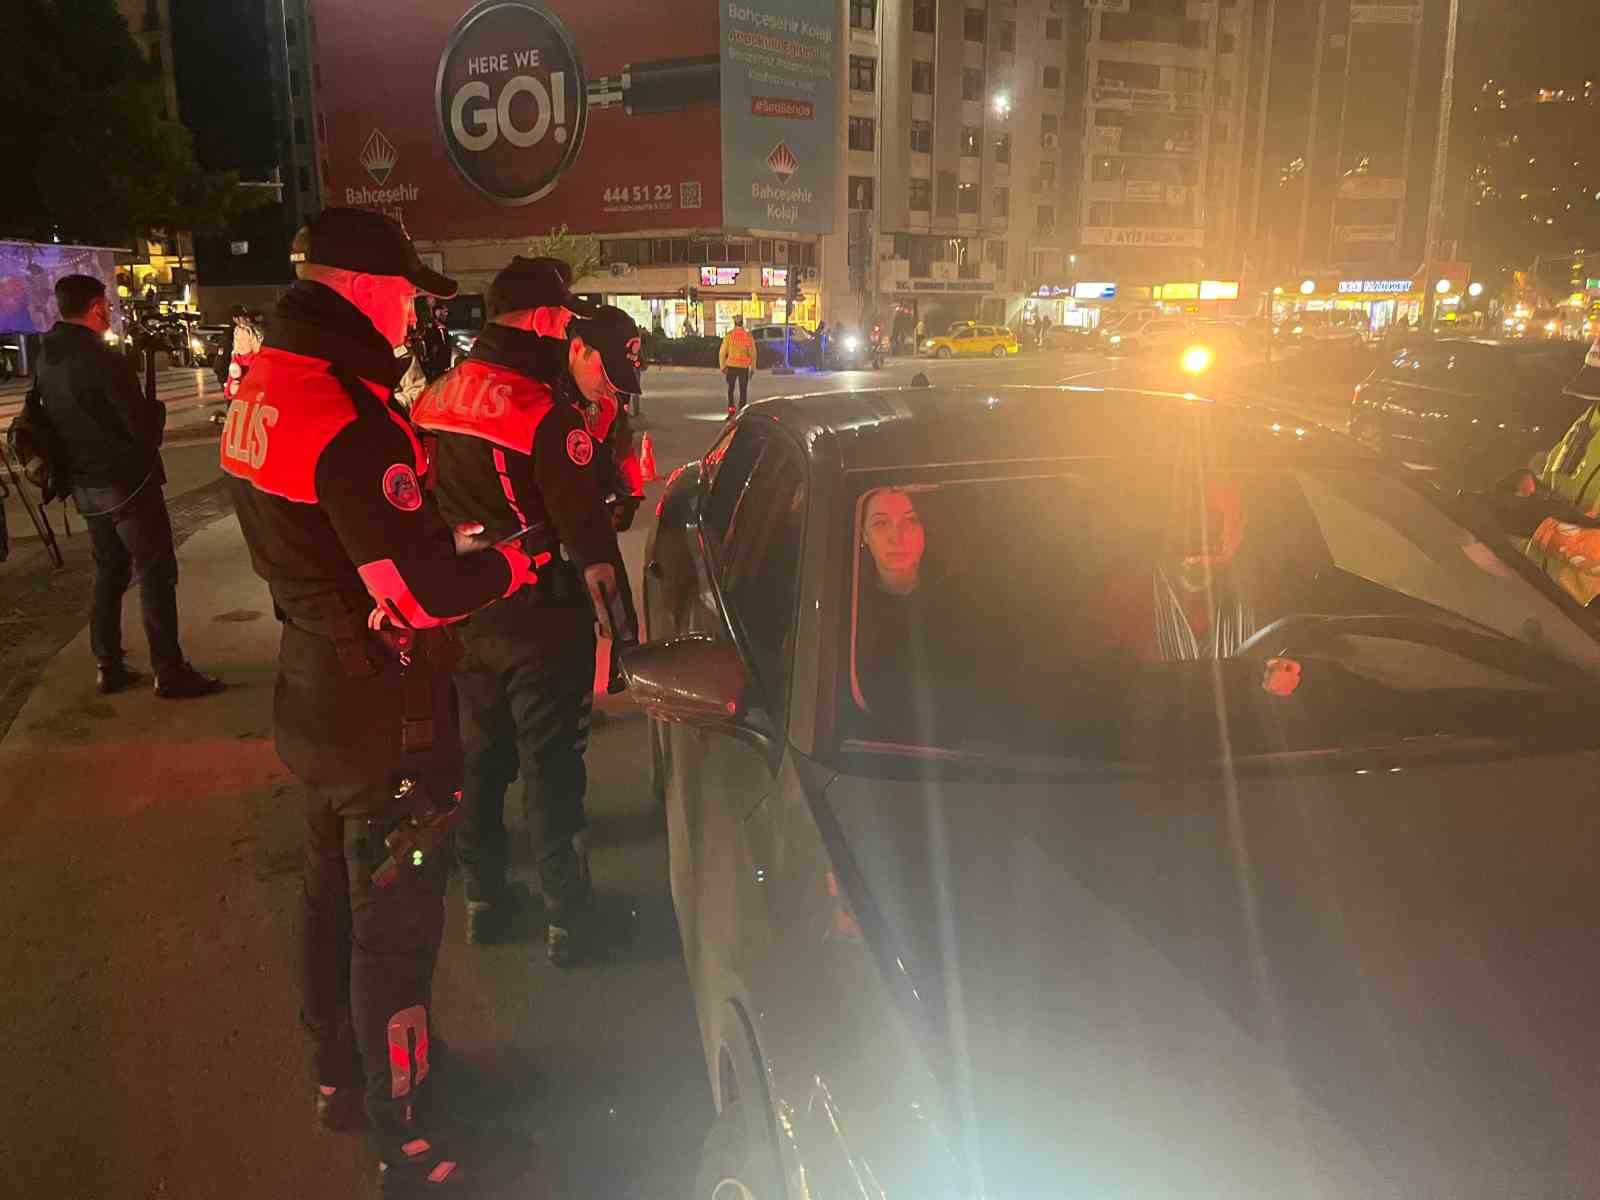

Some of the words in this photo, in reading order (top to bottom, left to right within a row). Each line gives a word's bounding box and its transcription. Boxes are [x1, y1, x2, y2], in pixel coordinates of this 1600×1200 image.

[467, 53, 509, 76] HERE
[513, 49, 540, 69] WE
[450, 71, 567, 152] GO!
[602, 186, 630, 203] 444
[632, 185, 650, 202] 51
[653, 183, 673, 201] 22
